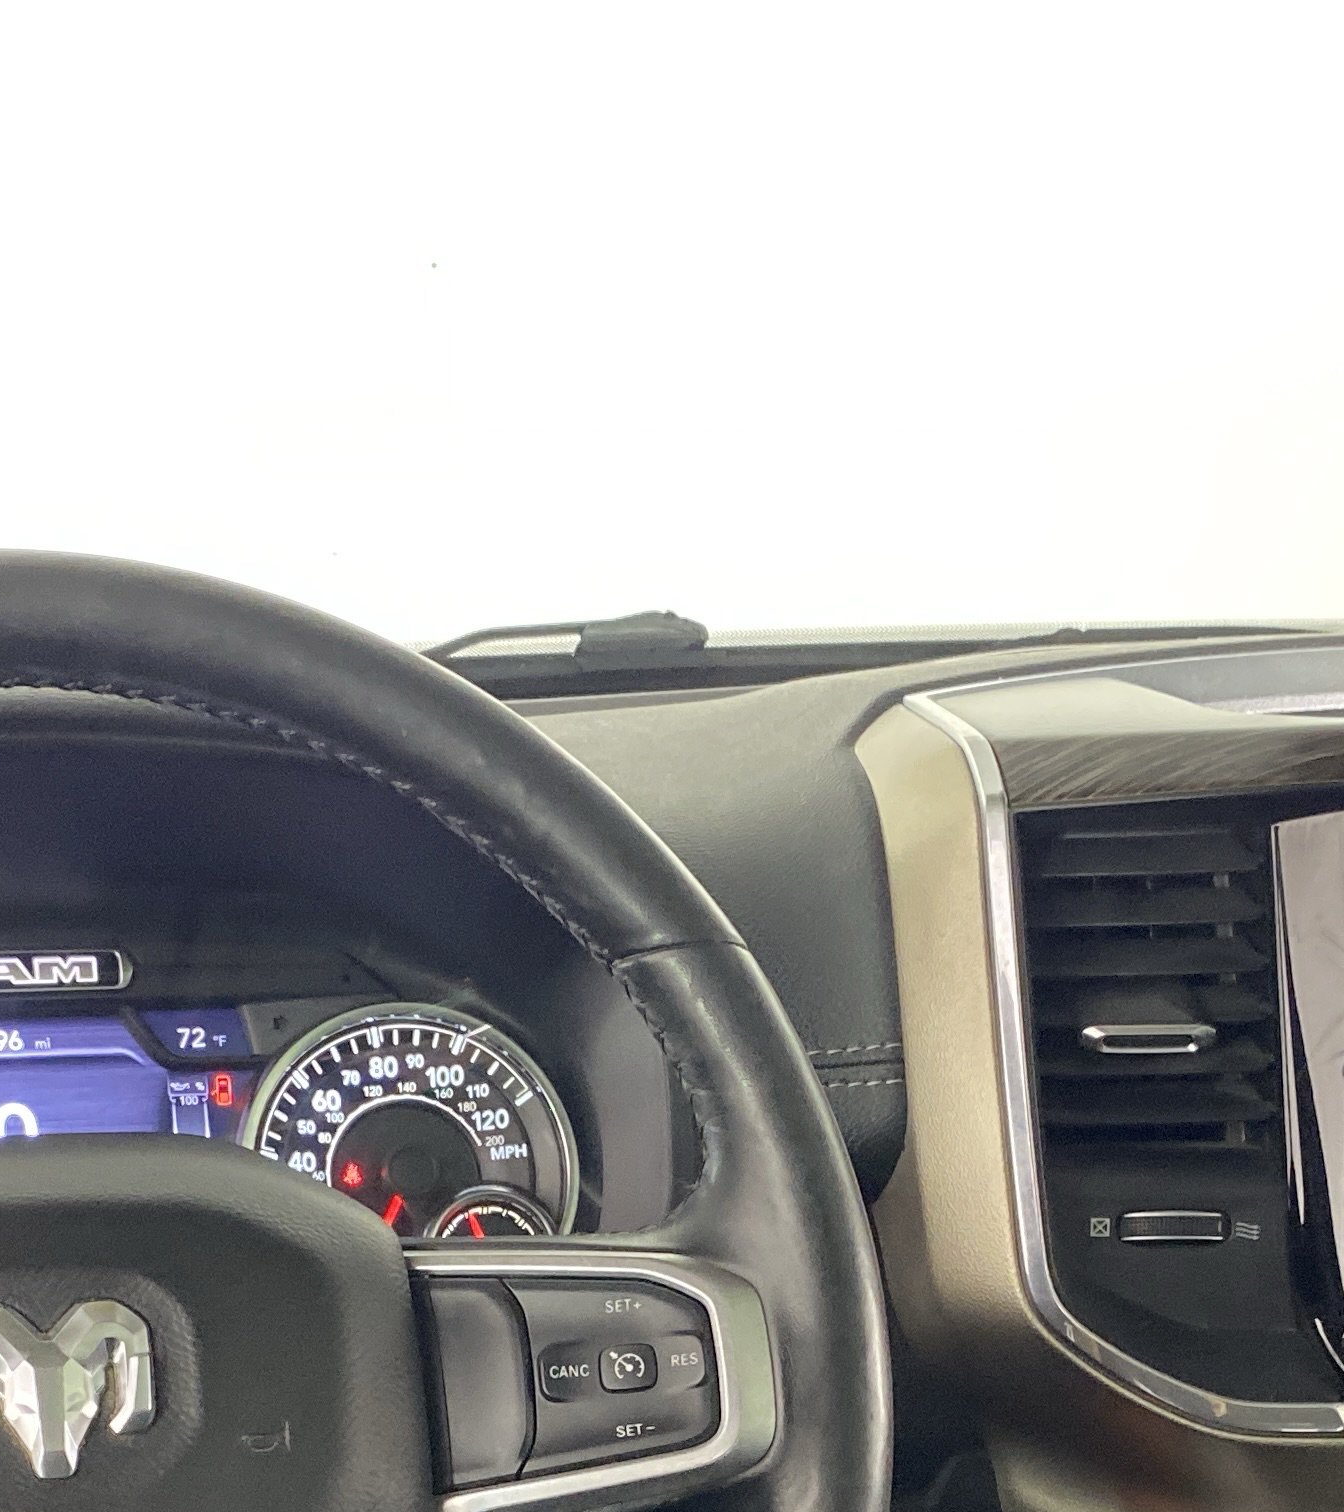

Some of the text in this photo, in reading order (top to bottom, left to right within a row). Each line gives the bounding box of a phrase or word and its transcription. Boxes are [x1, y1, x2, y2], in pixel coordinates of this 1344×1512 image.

[35, 1037, 51, 1050] mi
[176, 1027, 206, 1048] 72
[369, 1056, 398, 1078] 80
[405, 1054, 424, 1069] 90
[341, 1070, 360, 1086] 70
[425, 1065, 464, 1087] 100
[363, 1085, 382, 1097] 120
[397, 1082, 416, 1093] 140
[434, 1087, 453, 1099] 160
[466, 1085, 489, 1099] 110
[179, 1095, 199, 1106] 100
[311, 1089, 341, 1112] 60
[458, 1101, 477, 1112] 180
[325, 1112, 344, 1124] 100
[472, 1109, 509, 1131] 120
[297, 1119, 316, 1135] 50
[485, 1135, 505, 1147] 200
[490, 1144, 527, 1160] MPH
[288, 1151, 316, 1173] 40
[671, 1352, 699, 1367] RES
[549, 1364, 590, 1379] CANC
